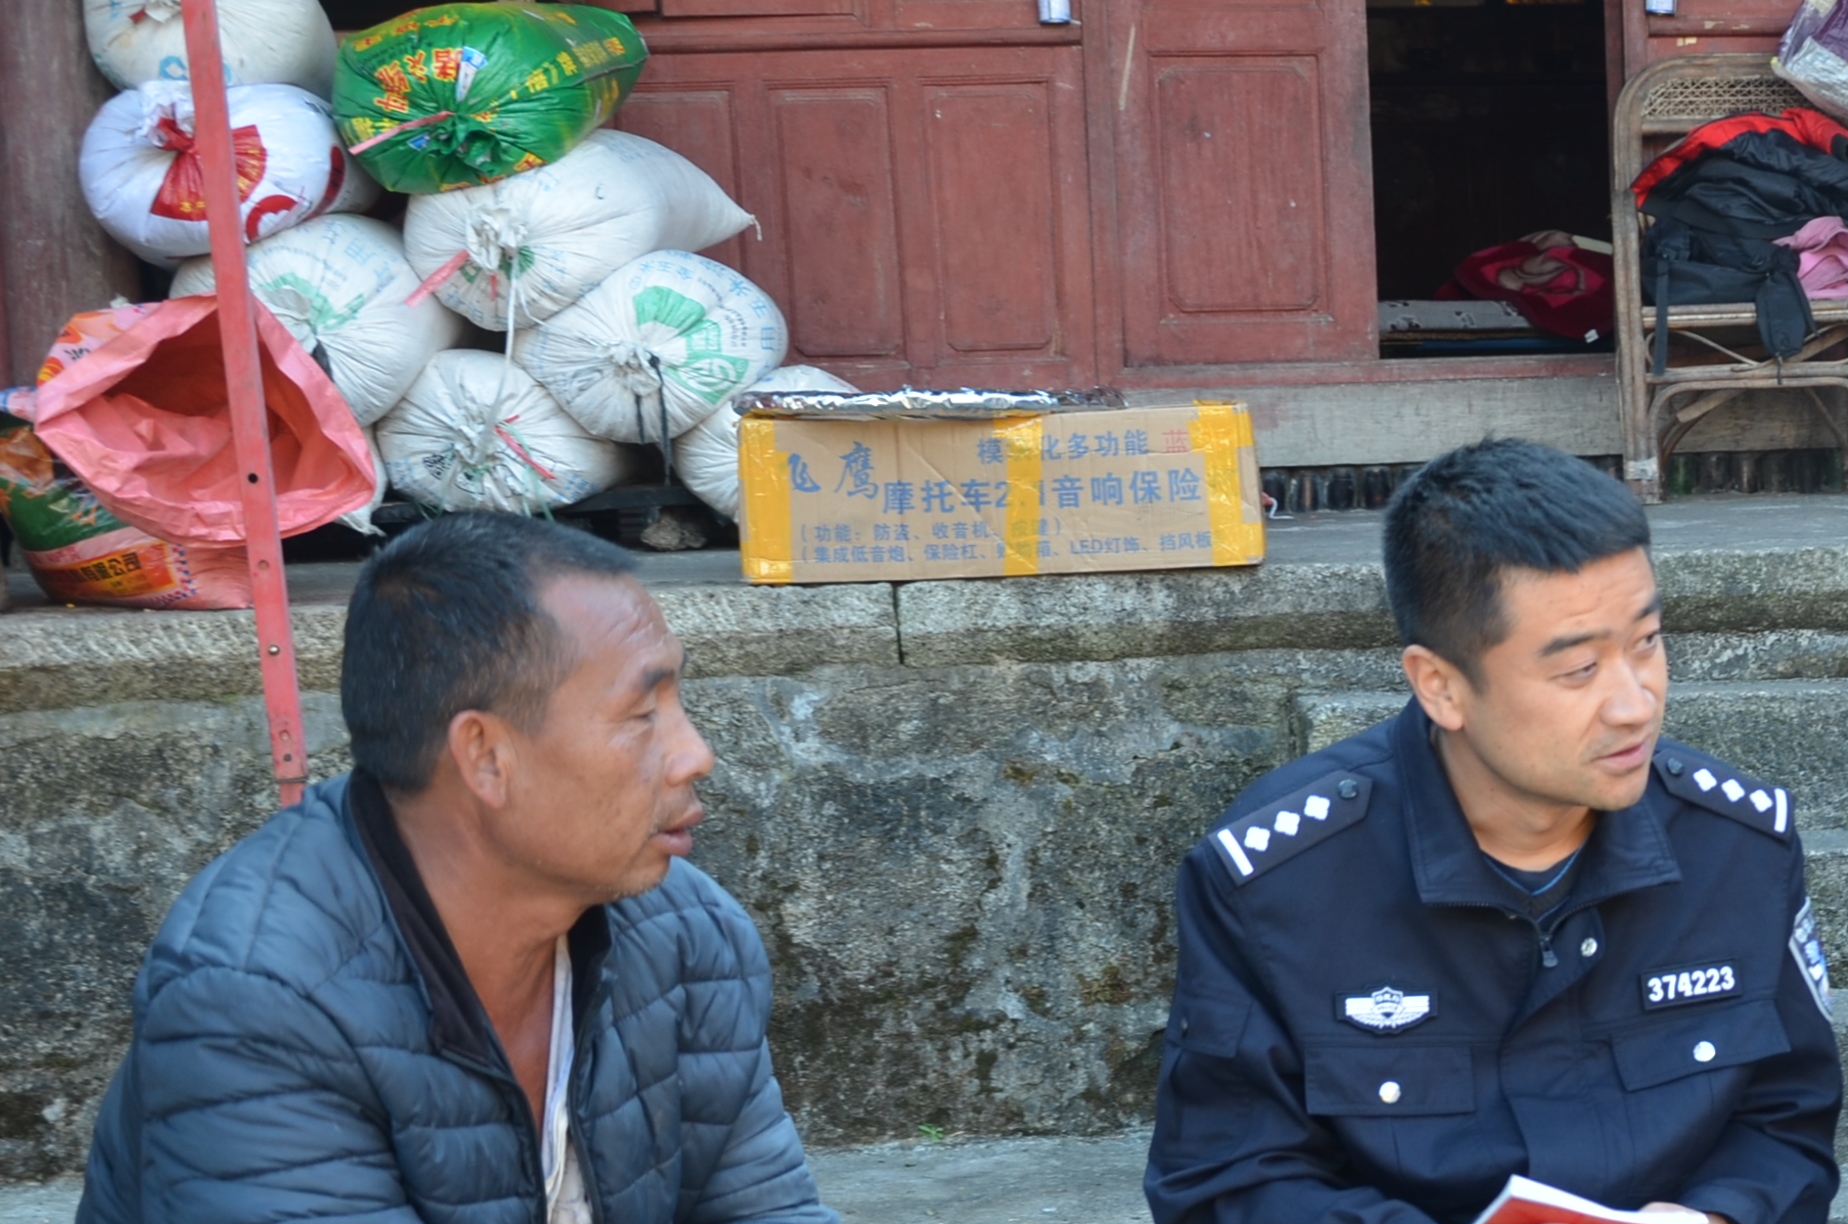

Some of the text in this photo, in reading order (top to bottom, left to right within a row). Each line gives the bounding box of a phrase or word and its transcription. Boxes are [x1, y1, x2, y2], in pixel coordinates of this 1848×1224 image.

[976, 429, 1150, 466] 模化多功能
[786, 441, 880, 501] 飞鹰
[881, 466, 1236, 516] 摩托车2.1音响保险
[1647, 965, 1736, 1003] 374223
